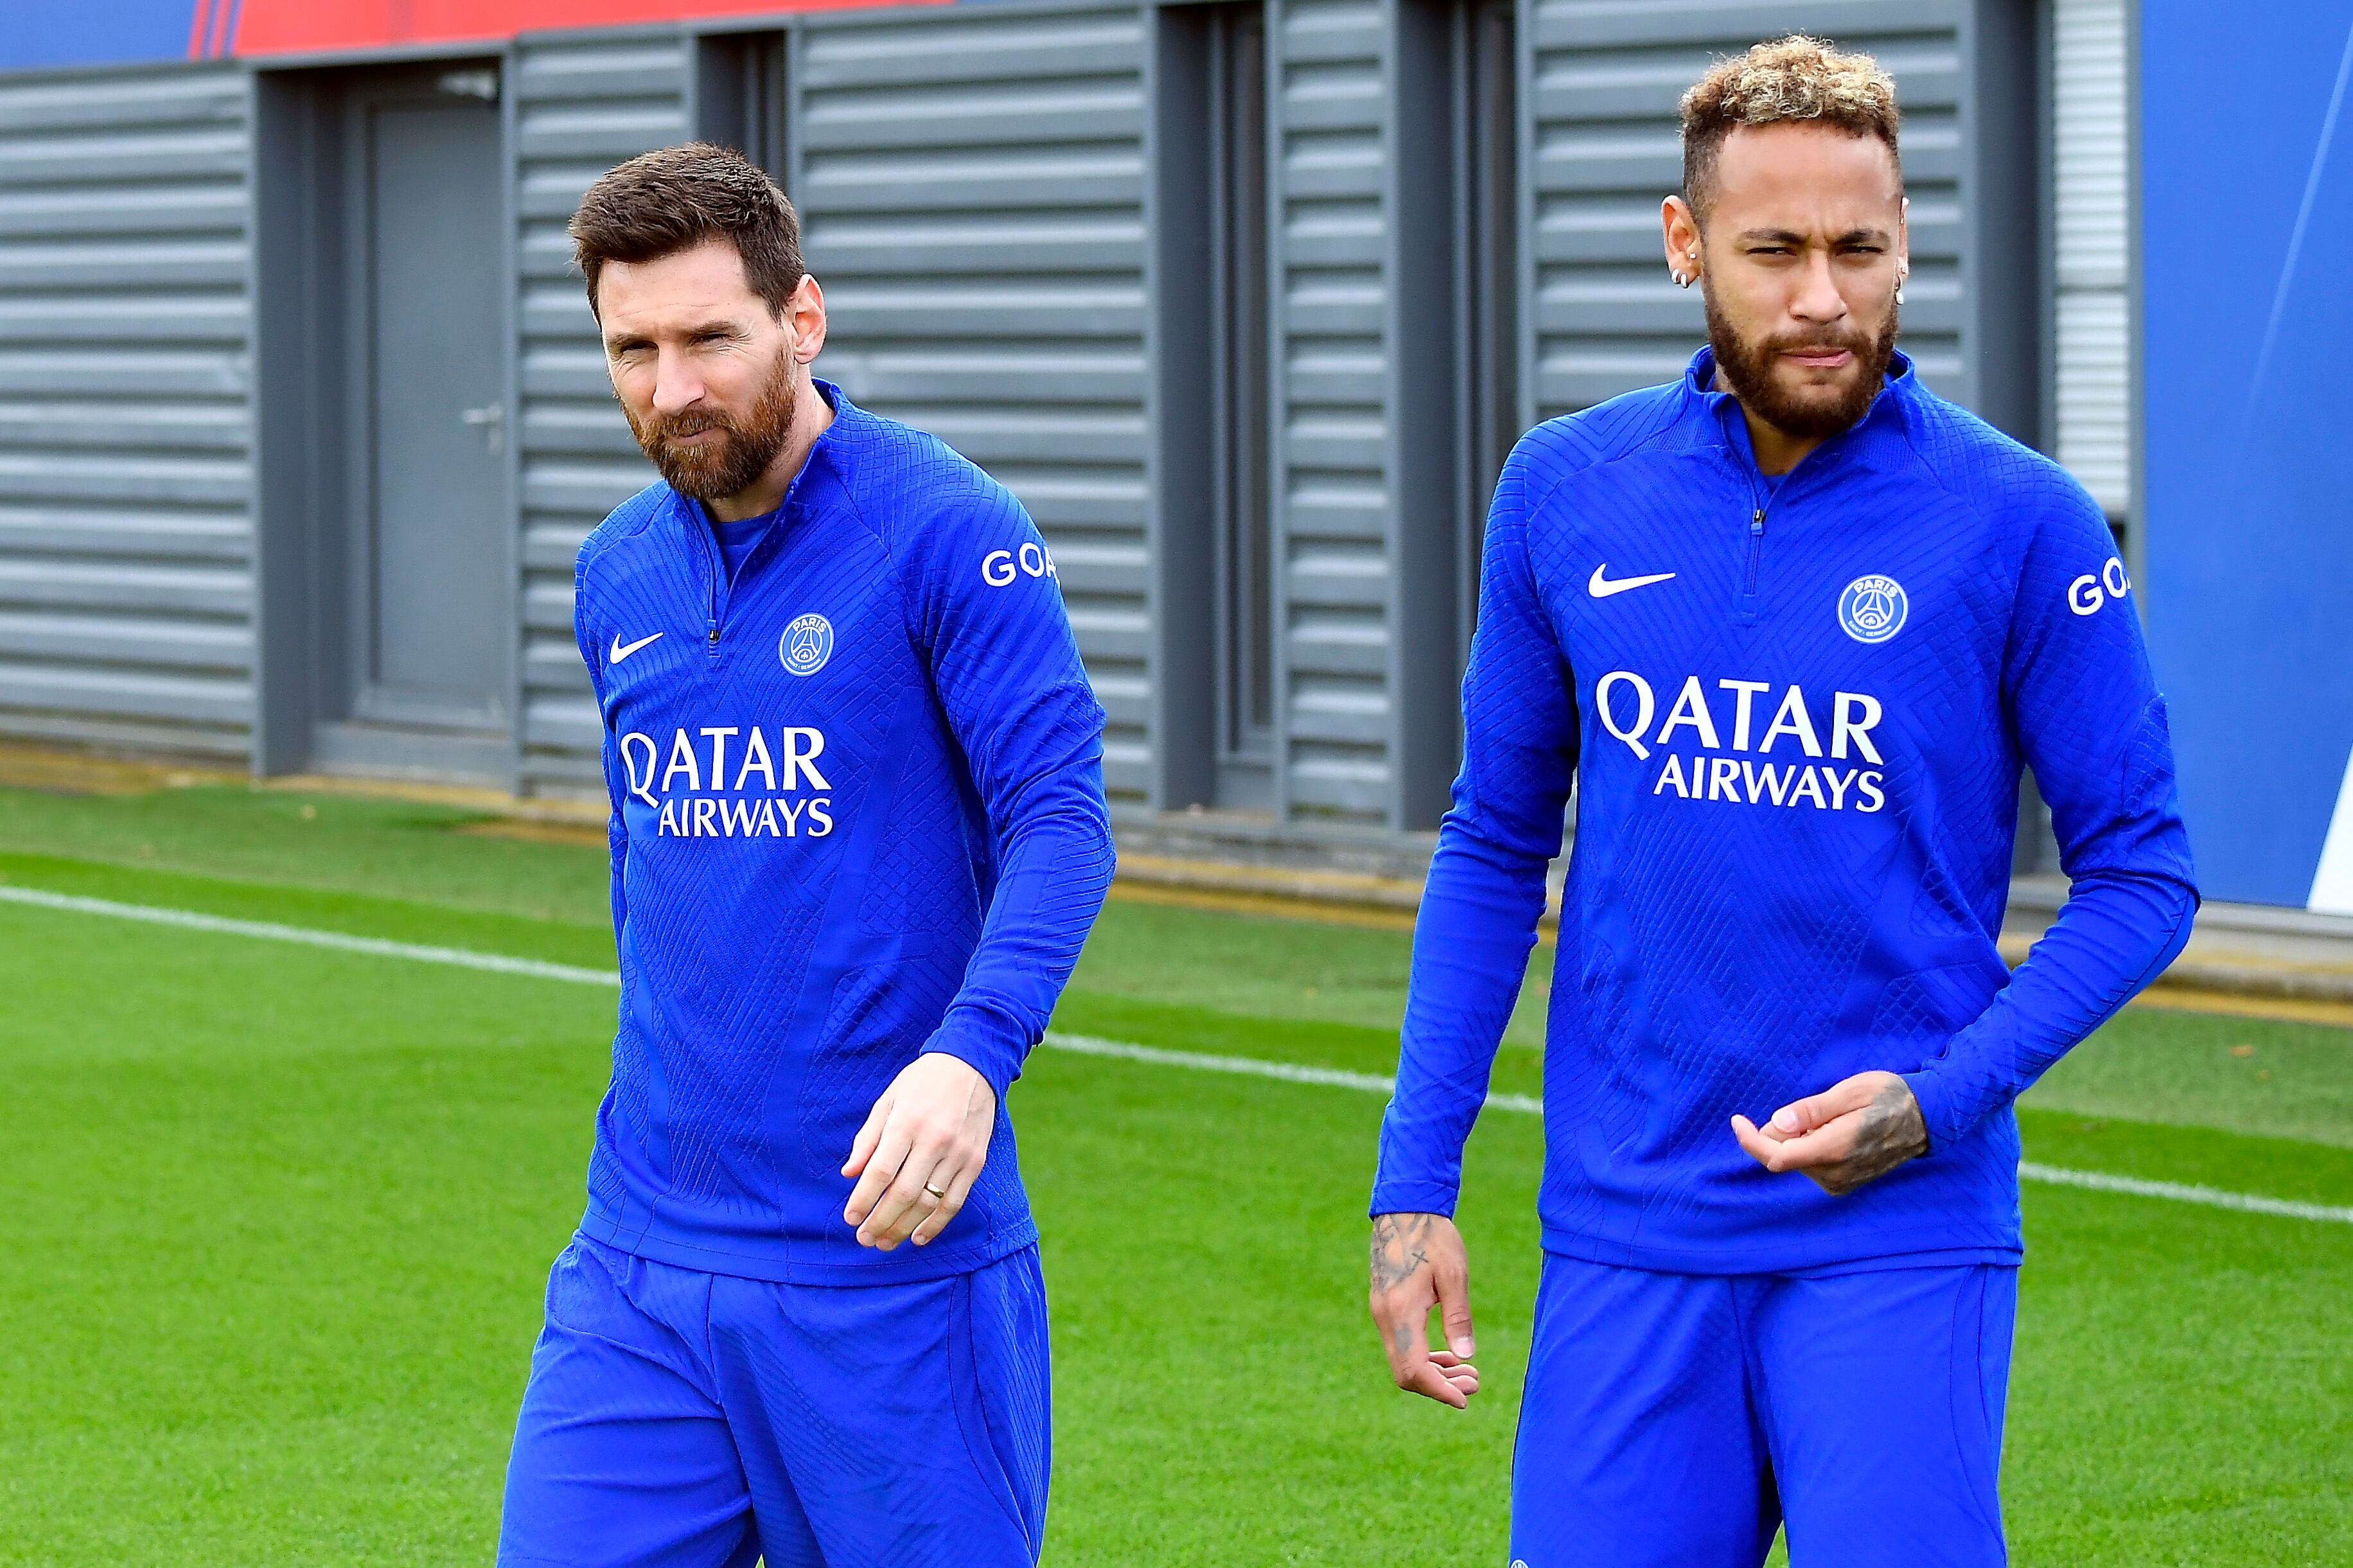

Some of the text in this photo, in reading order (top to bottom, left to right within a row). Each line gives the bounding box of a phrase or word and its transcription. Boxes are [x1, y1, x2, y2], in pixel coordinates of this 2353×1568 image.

[1853, 579, 1898, 597] PARIS
[2068, 557, 2132, 615] GO
[793, 617, 827, 633] PARIS
[1596, 671, 1884, 766] QATAR
[620, 726, 833, 809] QATAR
[1653, 753, 1885, 813] AIRWAYS
[658, 798, 834, 838] AIRWAYS
